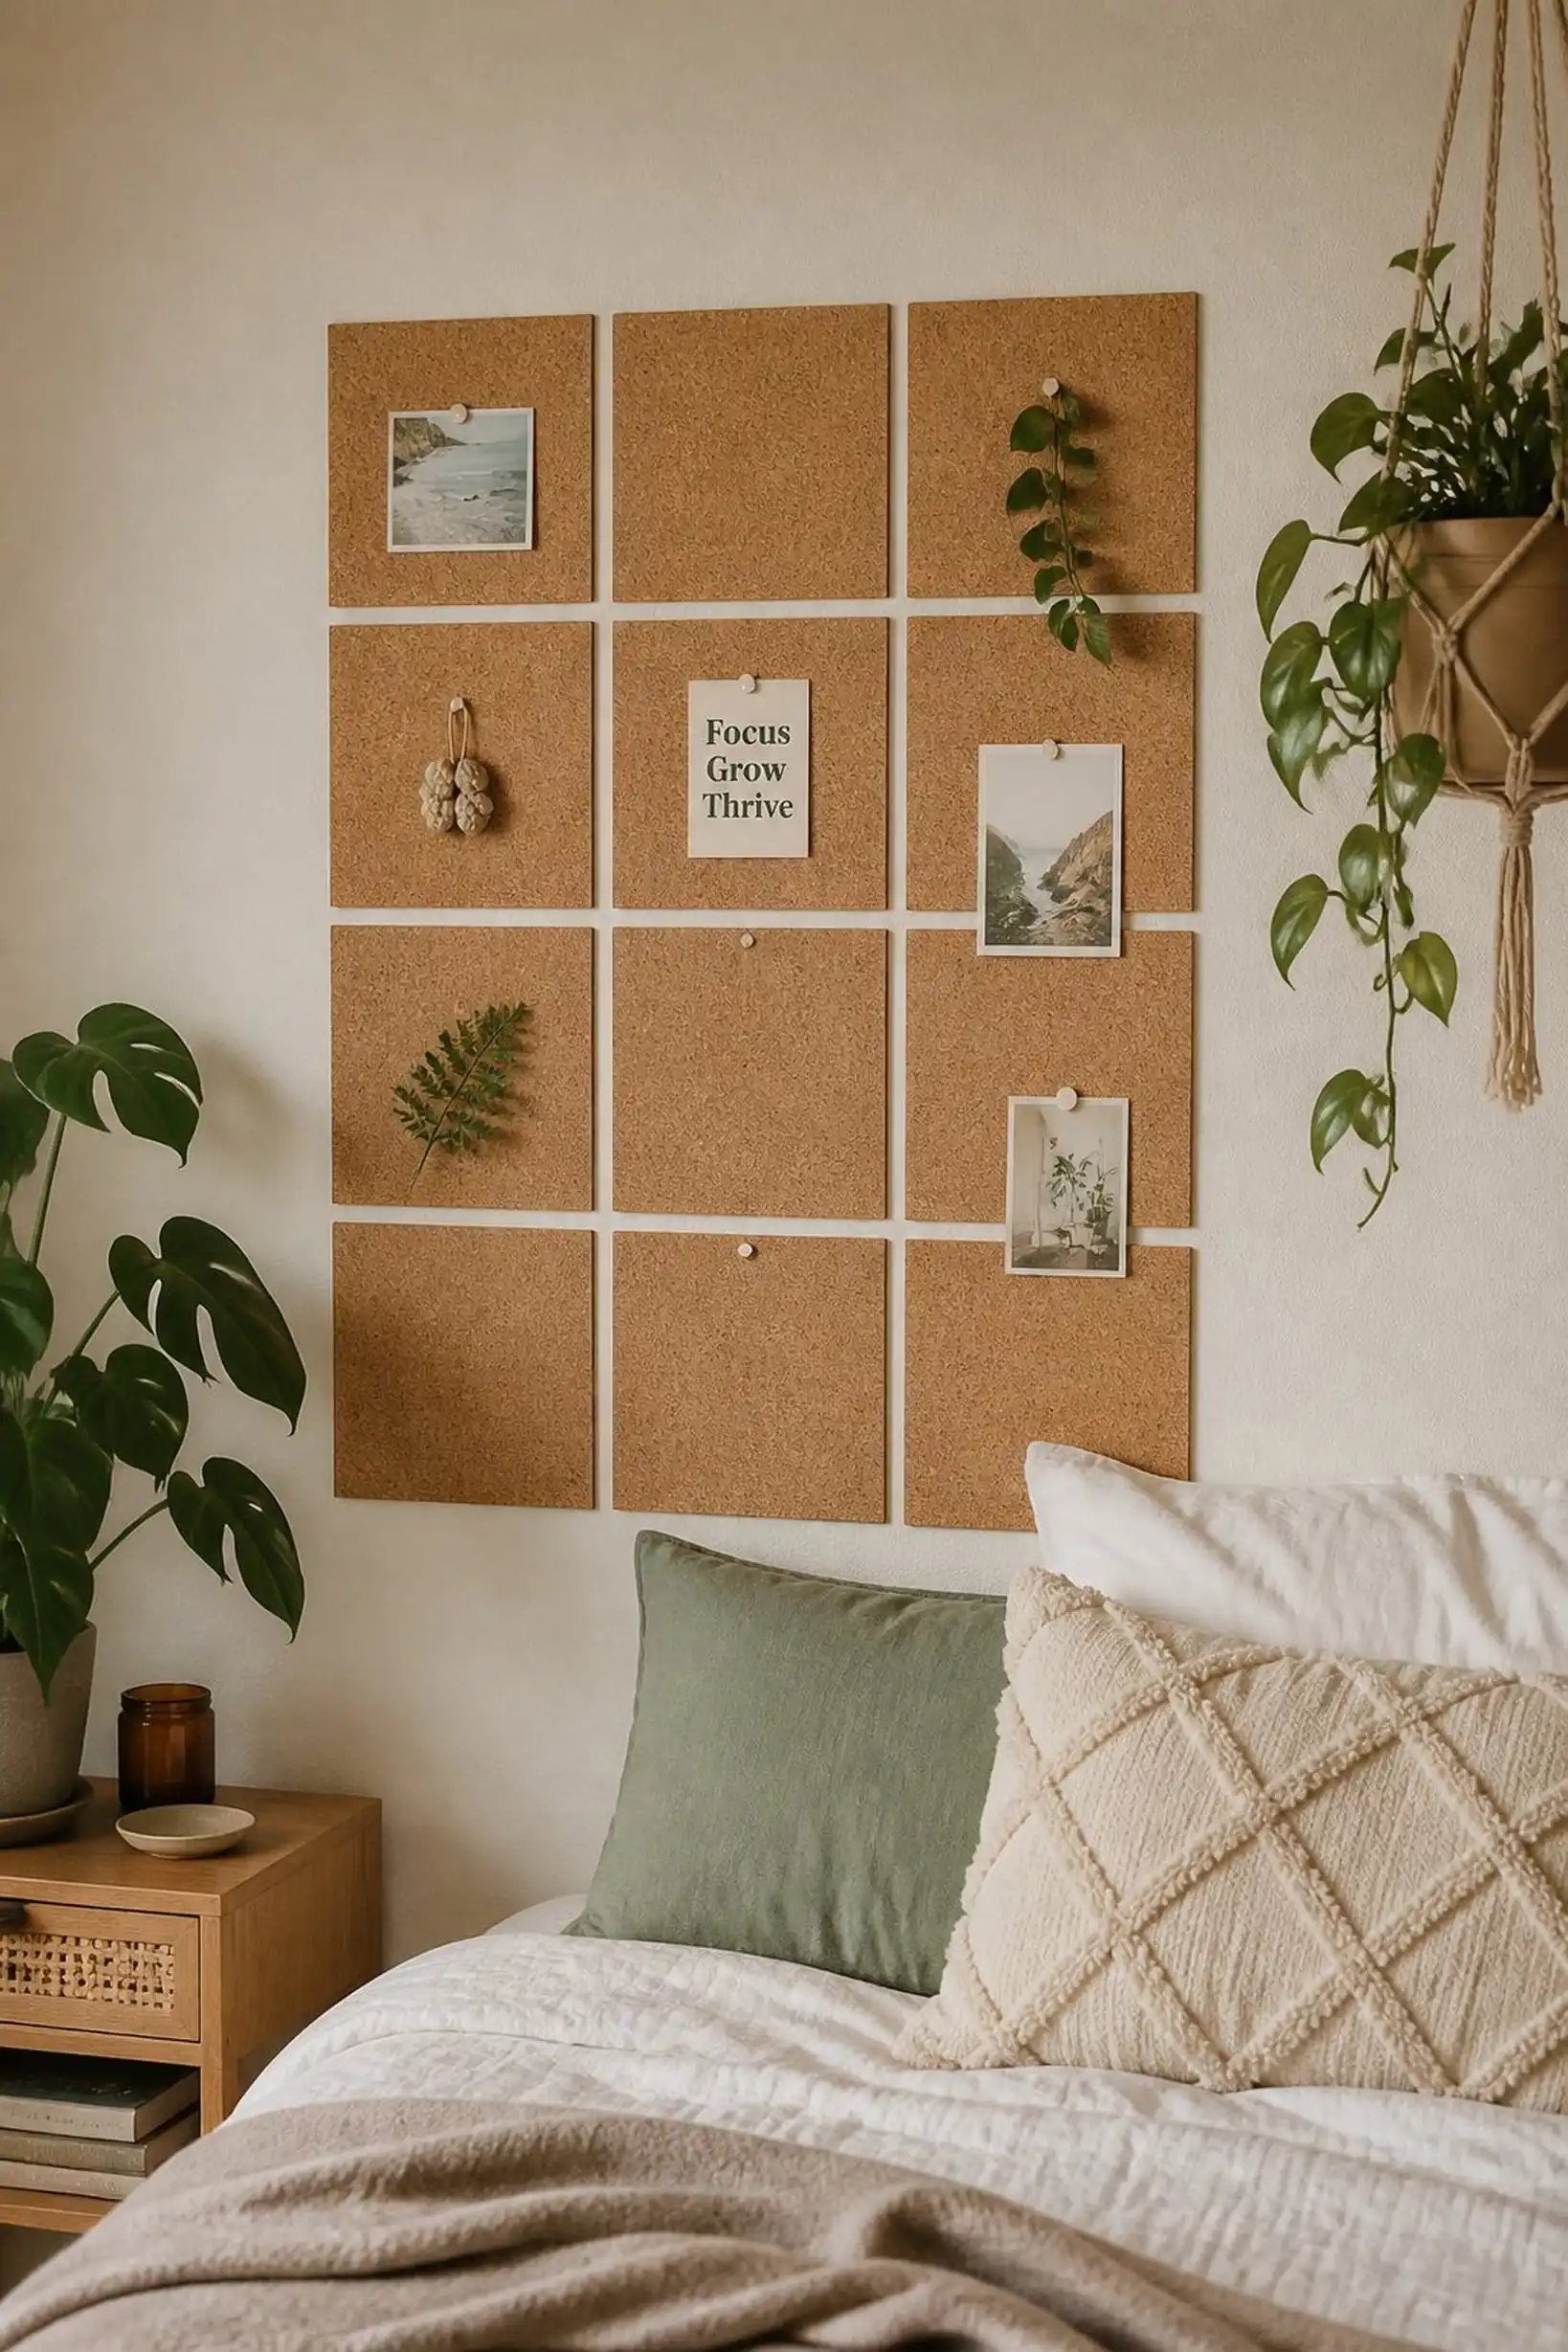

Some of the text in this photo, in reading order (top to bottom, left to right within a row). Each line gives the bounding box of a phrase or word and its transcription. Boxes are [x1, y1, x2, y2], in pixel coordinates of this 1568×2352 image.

[706, 719, 791, 746] Focus
[706, 755, 787, 782] Grow
[703, 792, 794, 818] Thrive
